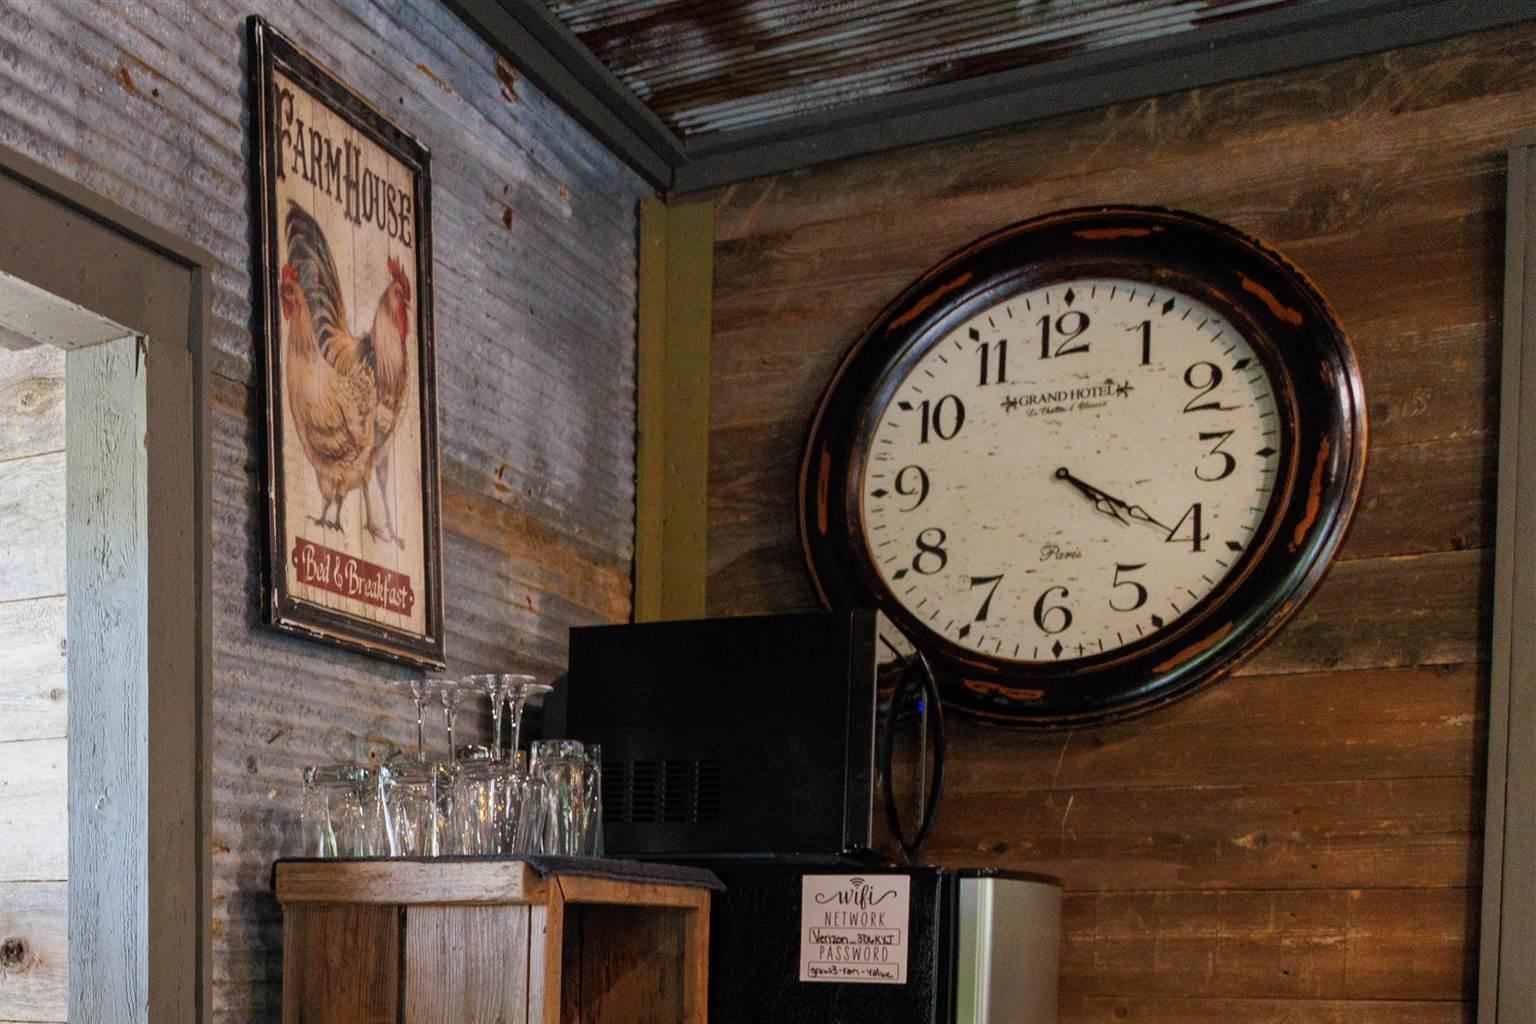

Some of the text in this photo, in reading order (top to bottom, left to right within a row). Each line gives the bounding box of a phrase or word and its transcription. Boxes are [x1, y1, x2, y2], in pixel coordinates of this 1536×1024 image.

[1037, 310, 1090, 360] 12
[1135, 319, 1152, 366] 1
[975, 339, 1009, 387] 11
[1018, 384, 1117, 407] GRAND HOTEL
[1183, 361, 1224, 414] 2
[917, 394, 966, 444] 10
[1194, 430, 1237, 482] 3
[894, 465, 931, 512] 9
[911, 527, 948, 575] 8
[1164, 502, 1211, 553] 4
[302, 544, 408, 609] Bed & Breakfast
[1040, 544, 1083, 561] Paris
[969, 574, 1005, 622] 7
[1032, 586, 1073, 634] 6
[1108, 563, 1149, 612] 5
[824, 911, 887, 927] NETWORK
[819, 945, 888, 961] PASSWORD
